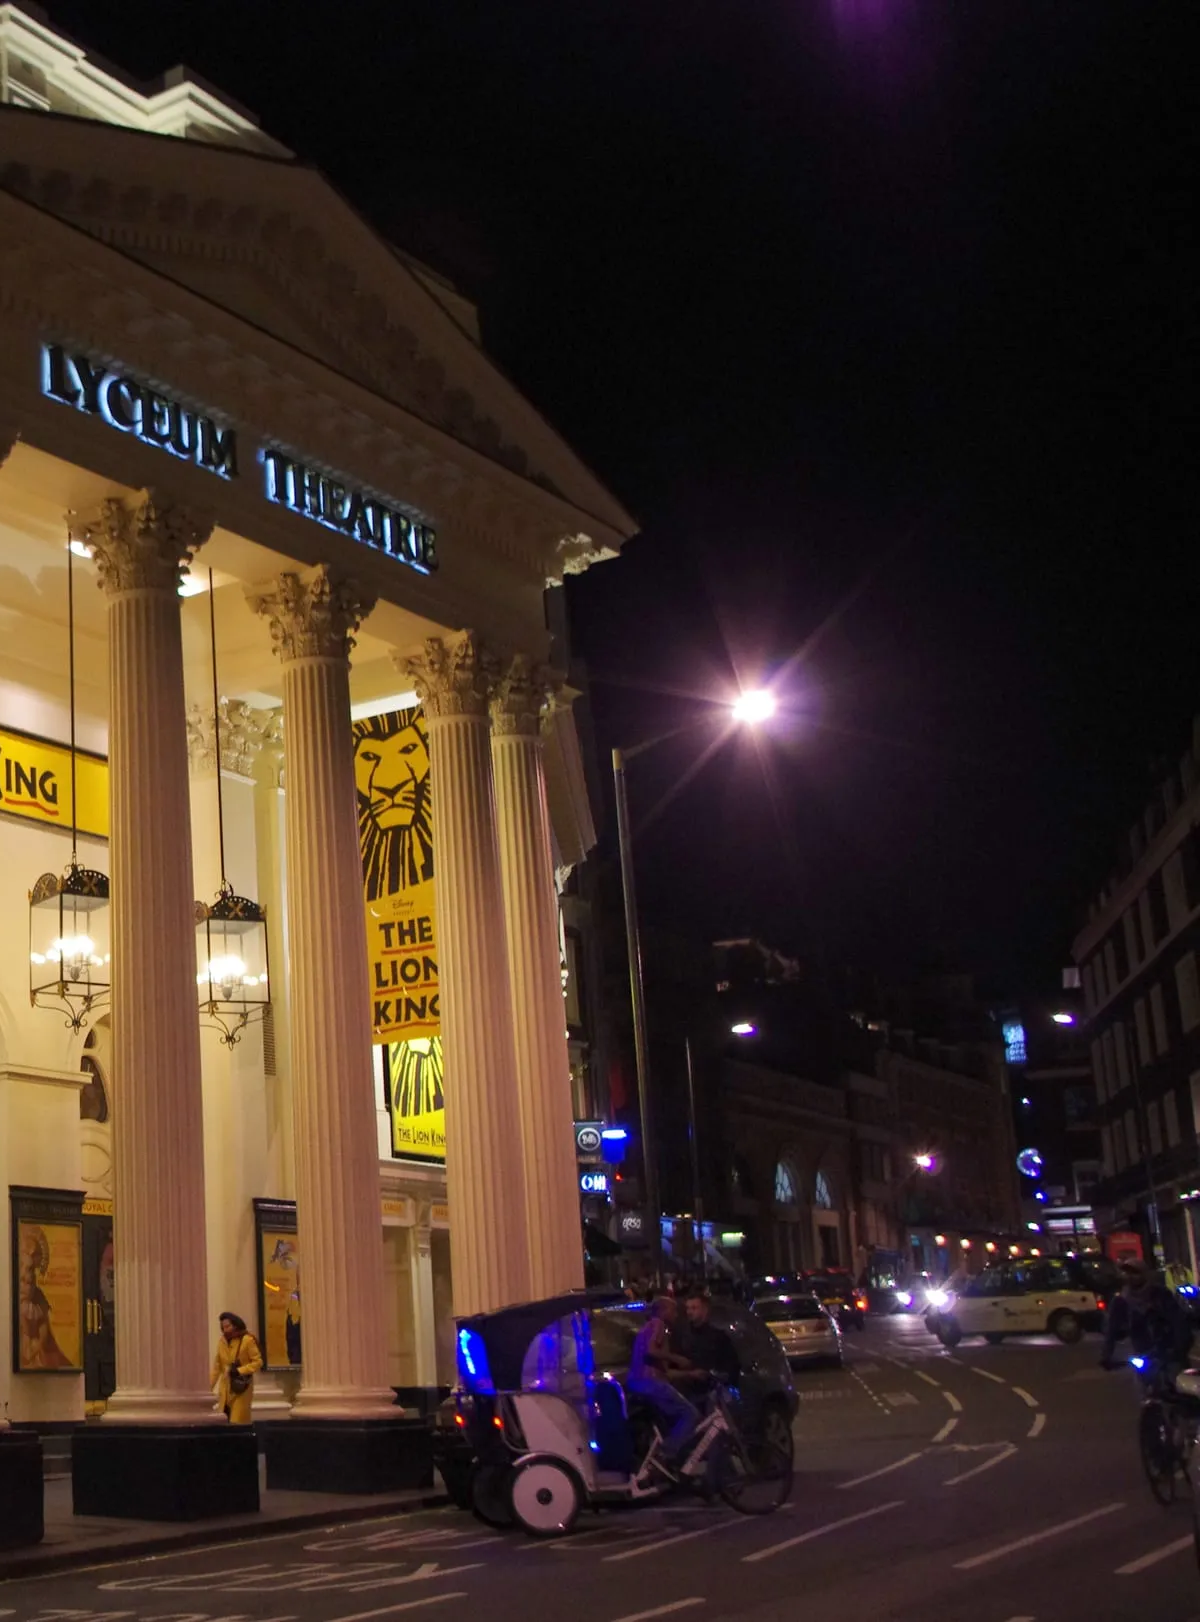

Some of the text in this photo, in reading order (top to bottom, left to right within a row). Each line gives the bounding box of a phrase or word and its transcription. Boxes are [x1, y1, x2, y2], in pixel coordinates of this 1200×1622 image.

[41, 341, 439, 576] LYCEUM THEATRE
[379, 916, 433, 948] THE
[374, 956, 439, 988] LION
[398, 1128, 411, 1140] THE
